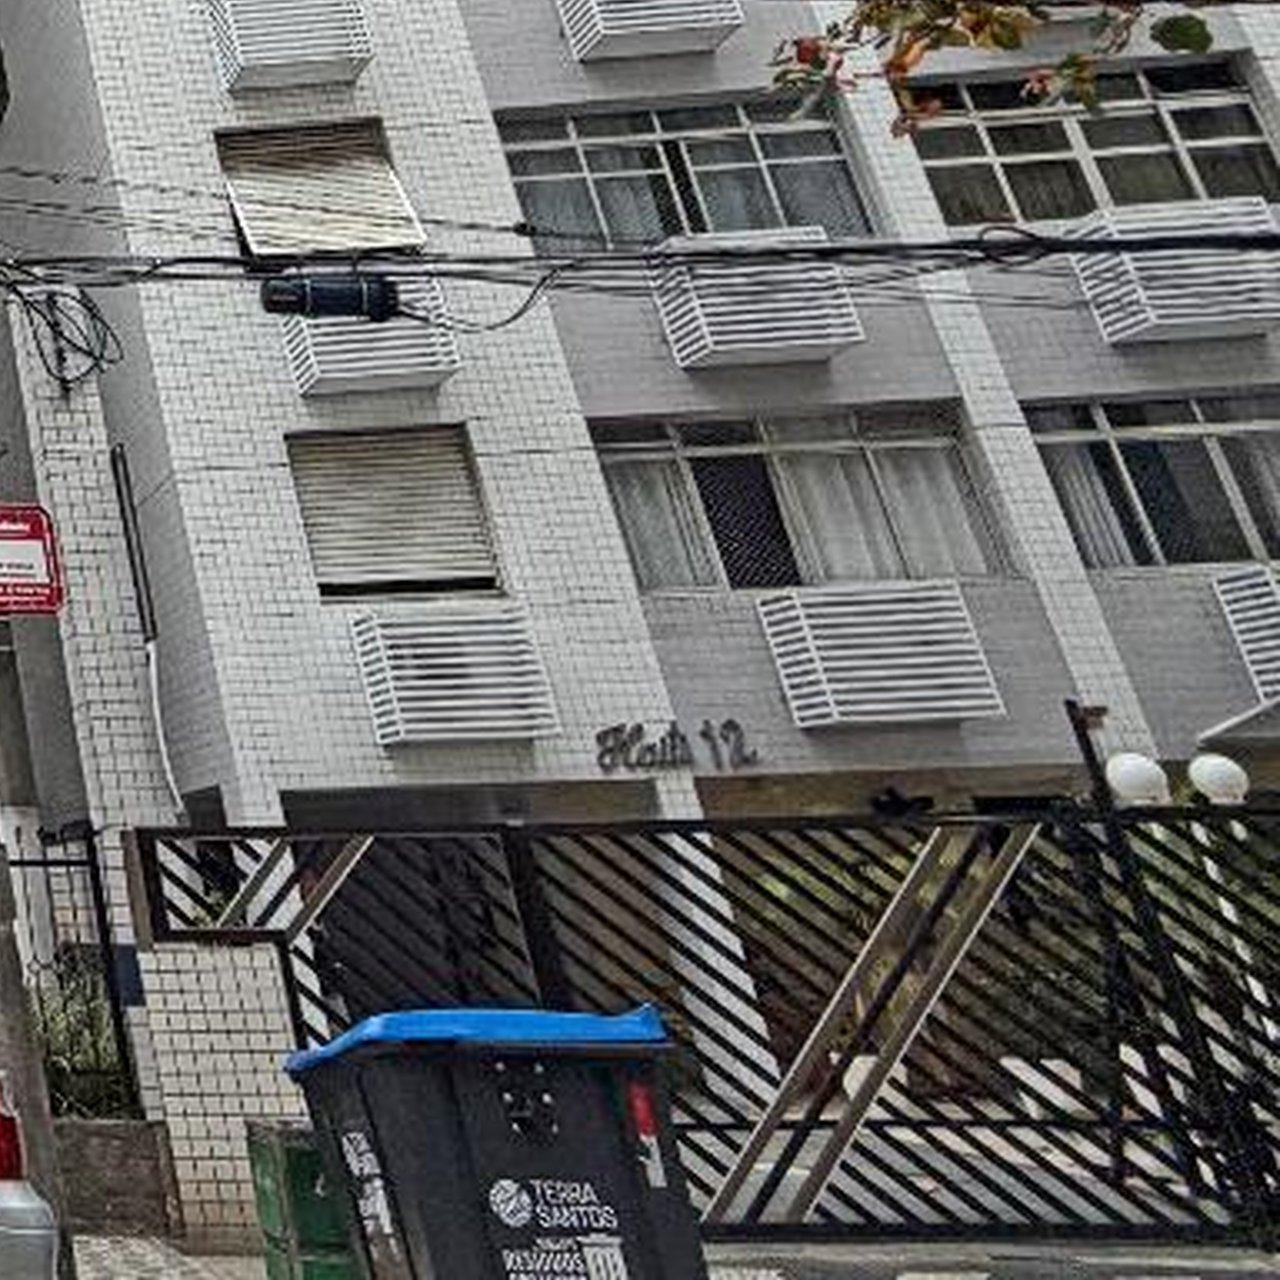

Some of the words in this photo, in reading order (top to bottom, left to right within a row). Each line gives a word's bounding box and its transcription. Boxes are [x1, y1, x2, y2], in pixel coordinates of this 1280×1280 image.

[699, 719, 759, 772] 12
[530, 1179, 599, 1204] TERRA
[536, 1205, 618, 1228] SANTOS
